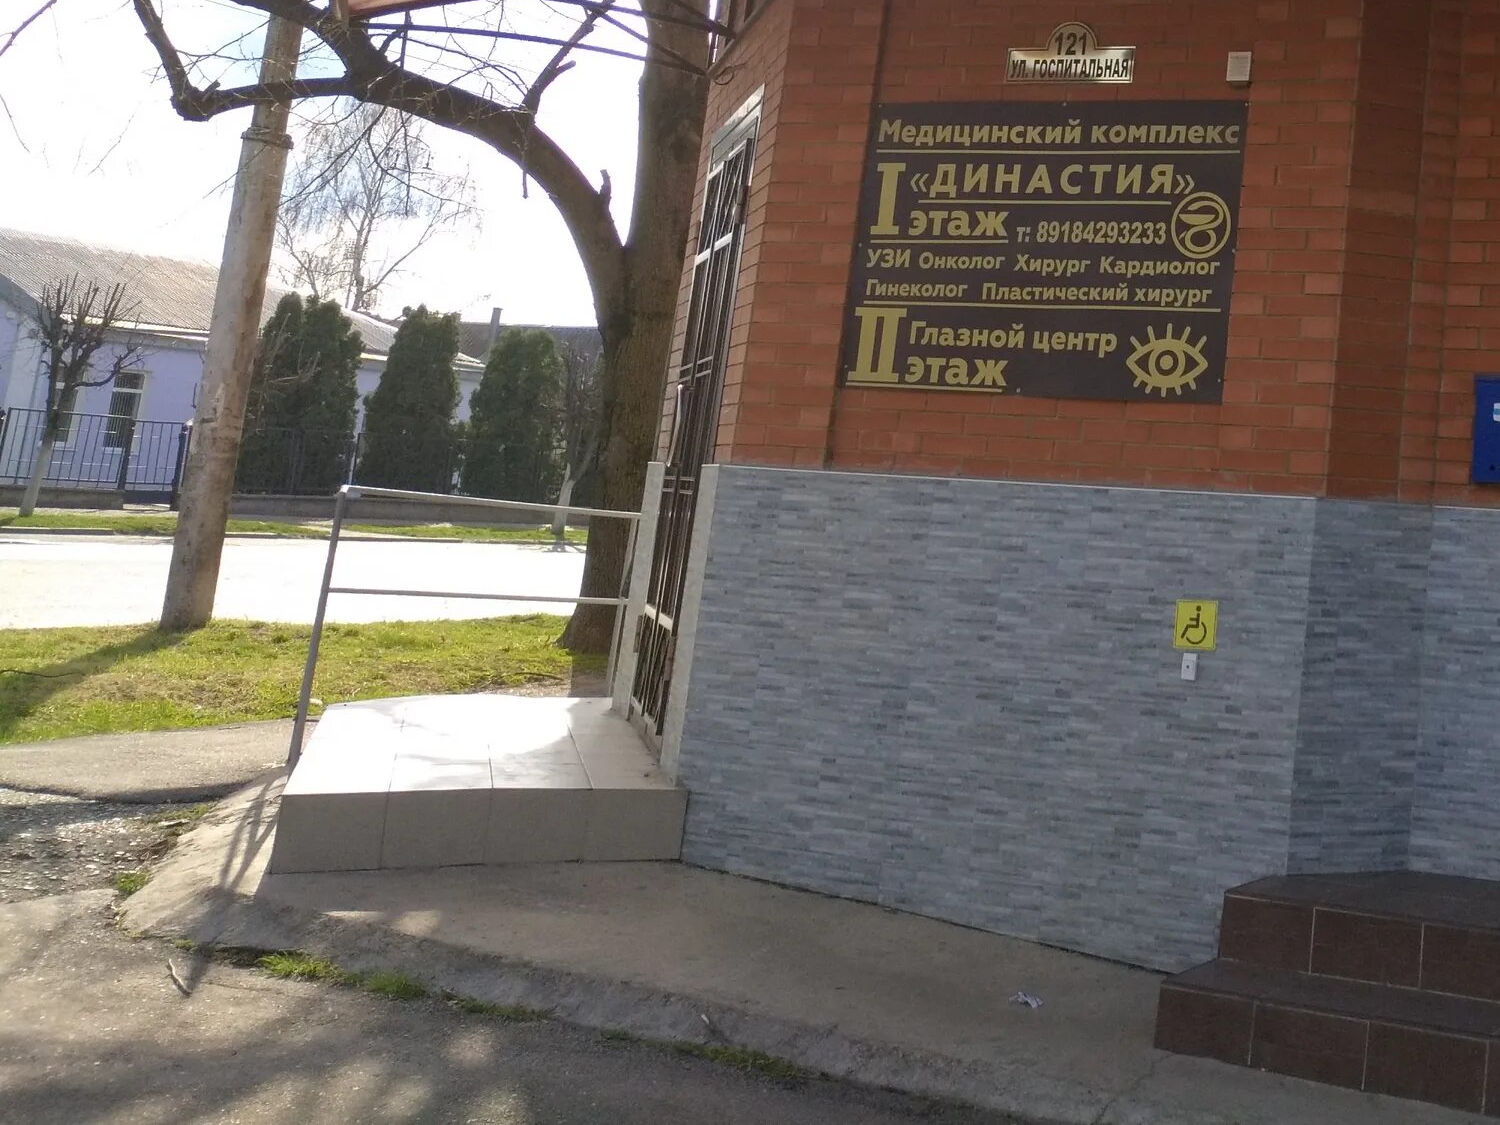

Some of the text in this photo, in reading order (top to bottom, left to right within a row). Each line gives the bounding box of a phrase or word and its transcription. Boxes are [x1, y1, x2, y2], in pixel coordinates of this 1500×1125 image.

[1054, 32, 1088, 56] 121
[1032, 58, 1129, 79] ГОСПИТАЛЬНАЯ
[878, 118, 1240, 146] Медицинский комплекс
[910, 163, 1195, 198] «ДИНАСТИЯ»
[909, 210, 1009, 237] этаж
[1016, 221, 1167, 245] т: 89184293233
[866, 249, 1220, 277] УЗИ Онколог Хирург Кардиолог
[864, 279, 1212, 307] Гинеколог Пластический хирург
[910, 320, 1118, 357] Глазной центр
[906, 357, 1008, 386] этаж
